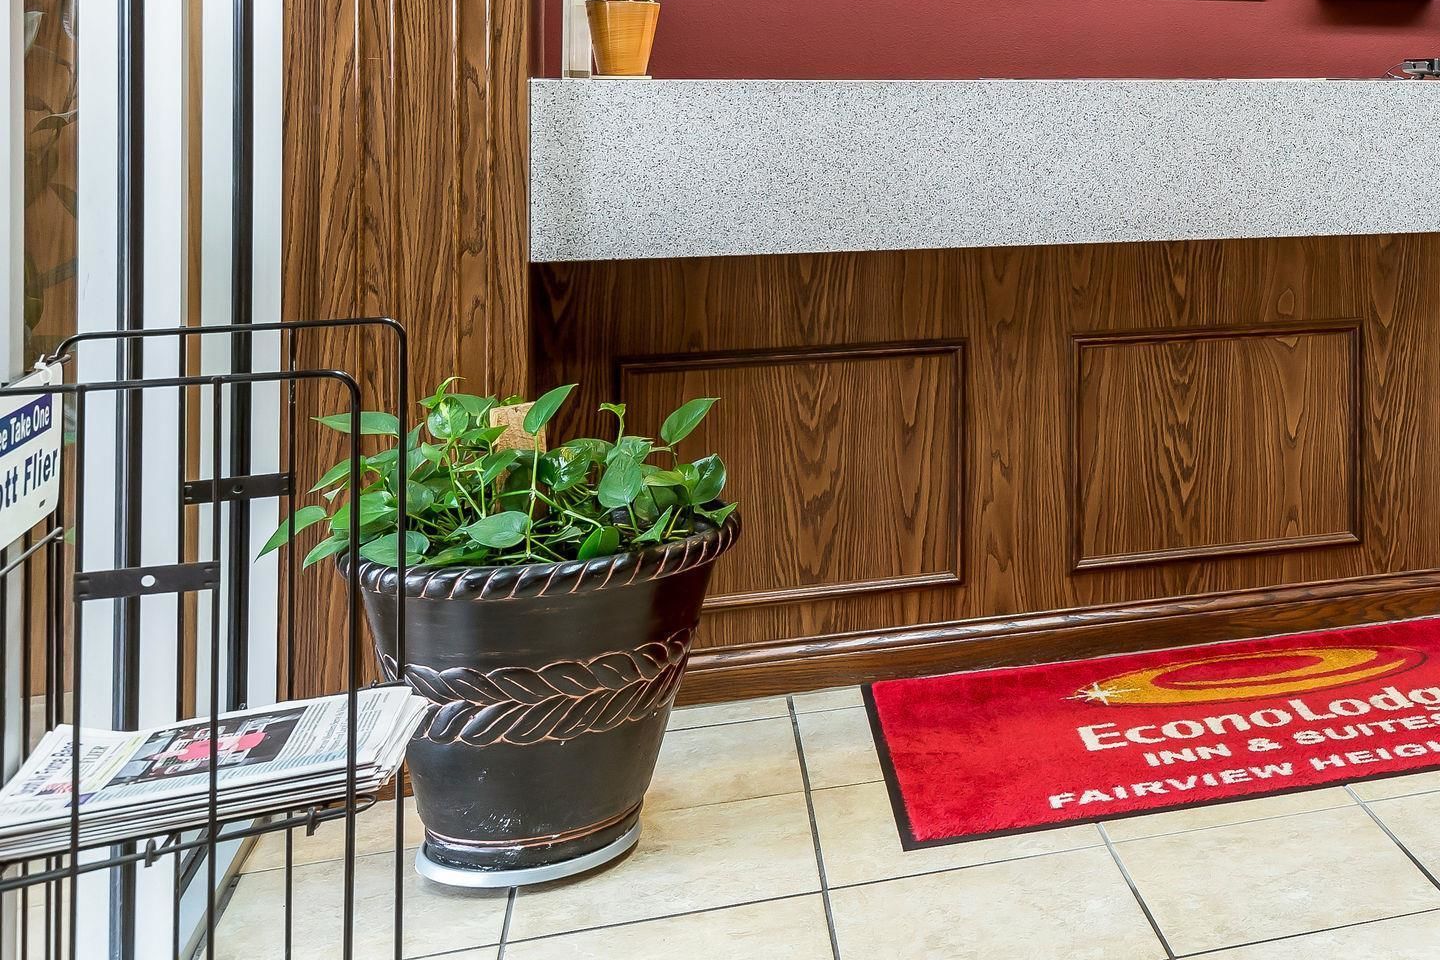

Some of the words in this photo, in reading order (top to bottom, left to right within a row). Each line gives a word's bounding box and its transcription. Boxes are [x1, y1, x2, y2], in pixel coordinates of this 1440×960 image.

[10, 412, 31, 445] Take
[33, 404, 49, 429] One
[24, 448, 58, 496] Flier
[1143, 743, 1231, 767] INN
[1248, 737, 1282, 753] &
[1049, 762, 1293, 810] FAIRVIEW
